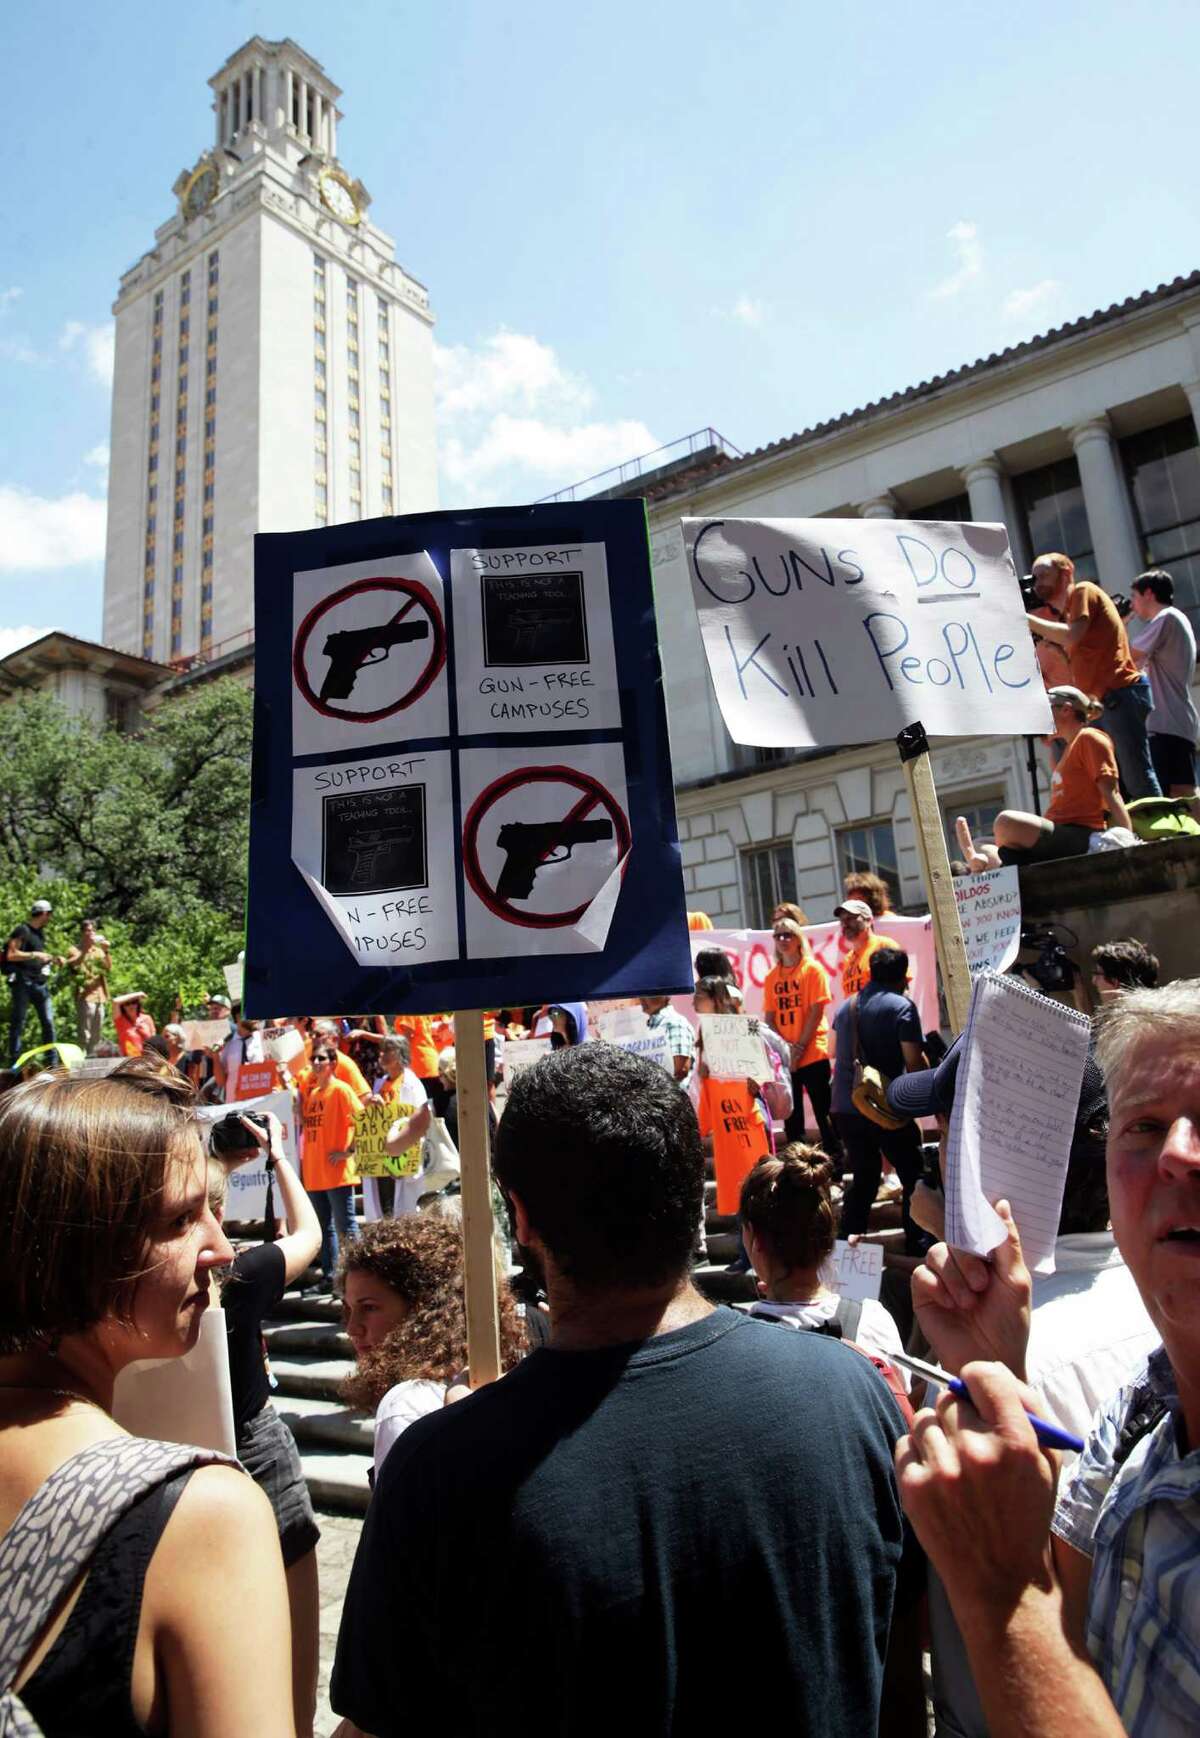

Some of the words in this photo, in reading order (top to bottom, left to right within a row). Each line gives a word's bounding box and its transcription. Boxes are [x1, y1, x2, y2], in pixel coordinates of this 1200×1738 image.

[471, 549, 582, 570] SUPPORT
[692, 522, 865, 604] GUNS
[896, 535, 977, 590] DO
[724, 624, 839, 700] Kill
[490, 697, 591, 719] CAMPUSES
[314, 758, 426, 790] SUPPORT
[774, 980, 800, 995] GUN
[352, 1103, 393, 1122] GUNS
[720, 1099, 744, 1114] GUN
[355, 1121, 378, 1138] LAB
